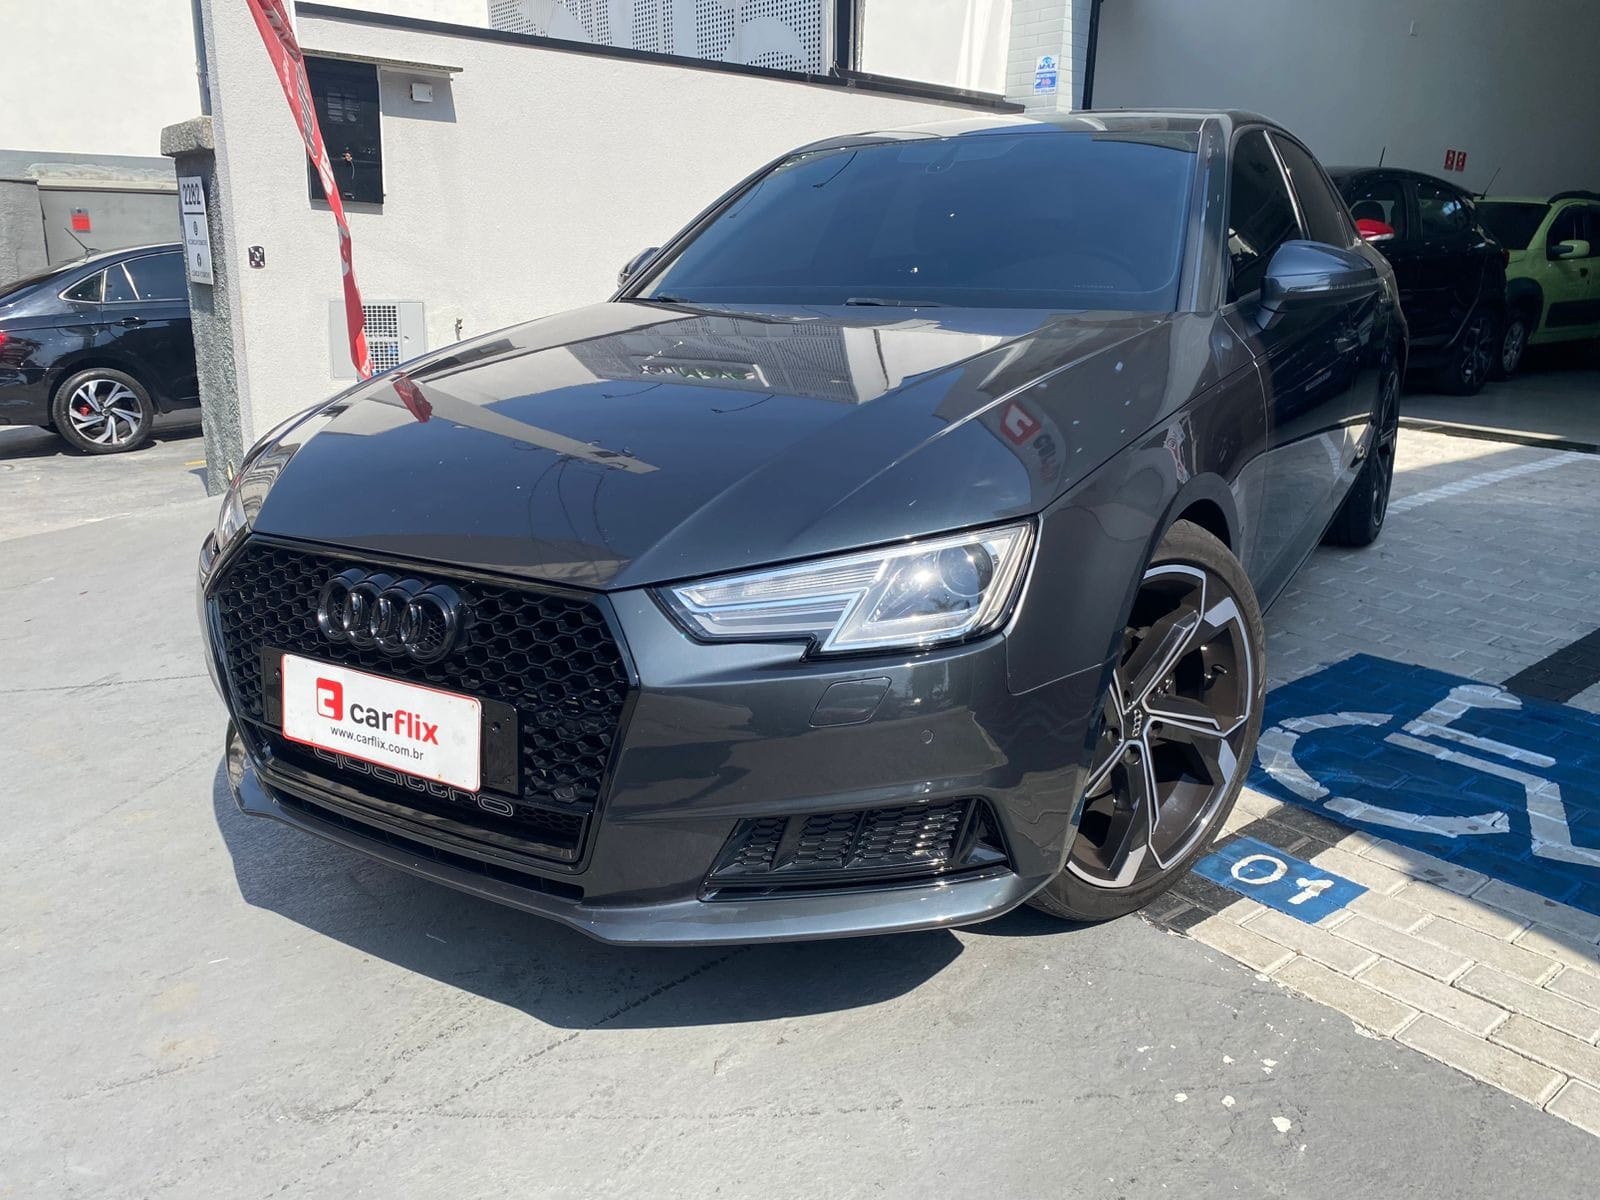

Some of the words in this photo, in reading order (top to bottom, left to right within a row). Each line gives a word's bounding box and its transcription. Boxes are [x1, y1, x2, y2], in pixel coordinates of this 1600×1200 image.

[182, 183, 201, 206] 2282
[349, 703, 439, 746] carflix
[330, 726, 424, 761] www.carflix.com.br
